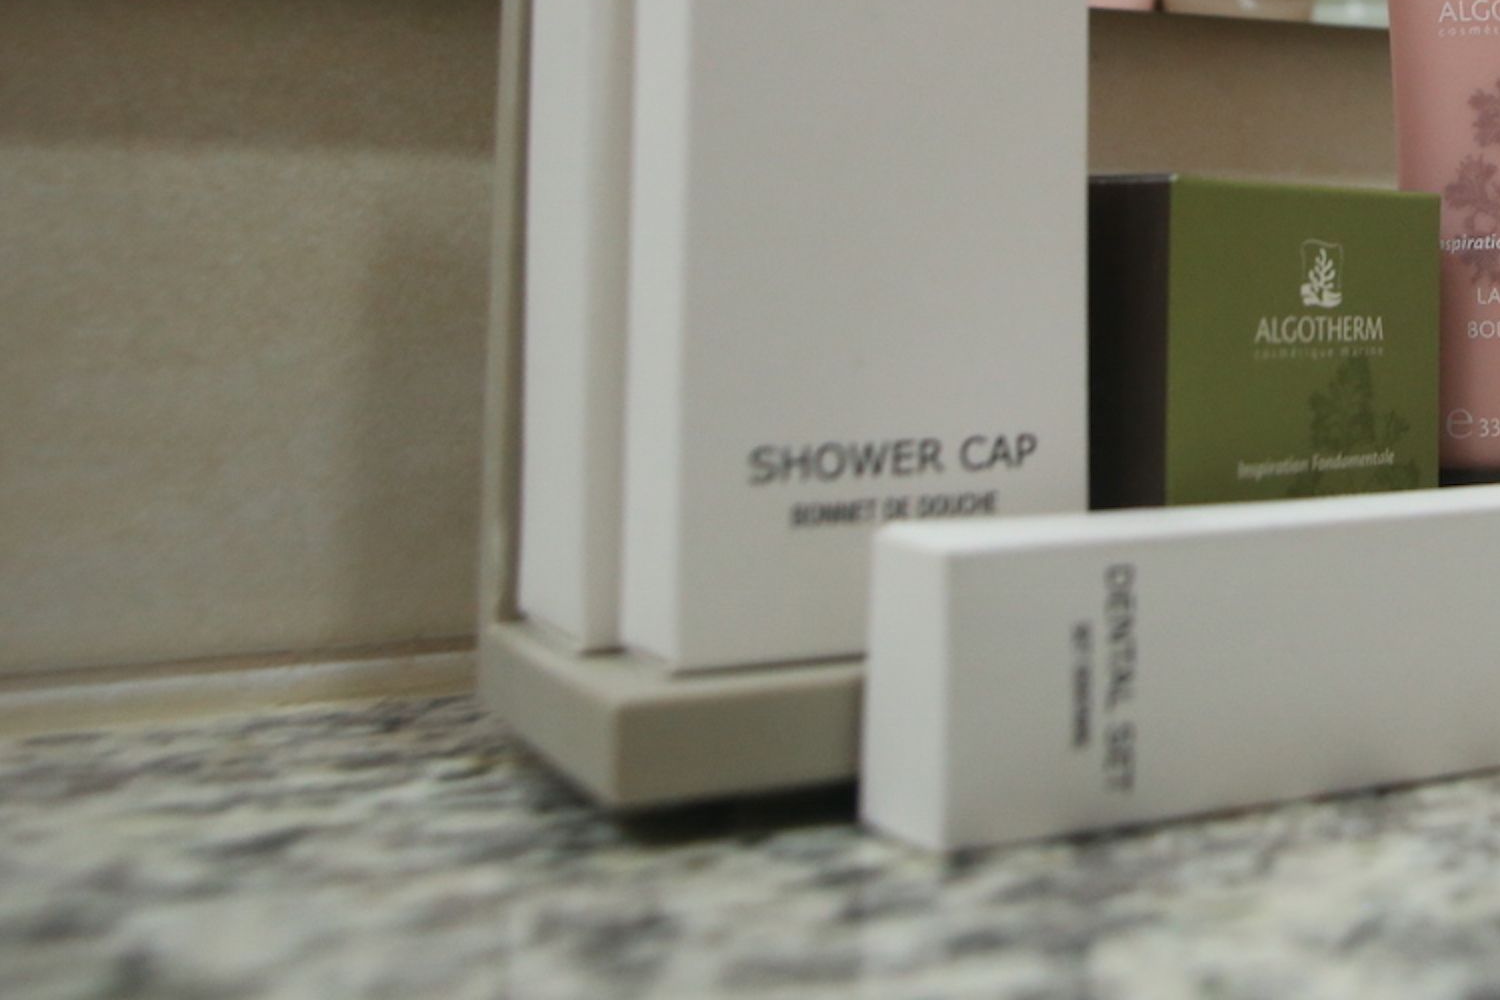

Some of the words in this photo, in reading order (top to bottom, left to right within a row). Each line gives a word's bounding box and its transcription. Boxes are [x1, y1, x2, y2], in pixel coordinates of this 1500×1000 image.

[1254, 315, 1384, 344] ALGOTHERM
[749, 437, 943, 487] SHOWER
[959, 432, 1038, 471] CAP
[790, 498, 876, 527] BONNET
[882, 496, 909, 521] DE
[915, 490, 998, 518] DOUCHE
[1105, 563, 1137, 712] DENTAL
[1105, 722, 1137, 792] SET
